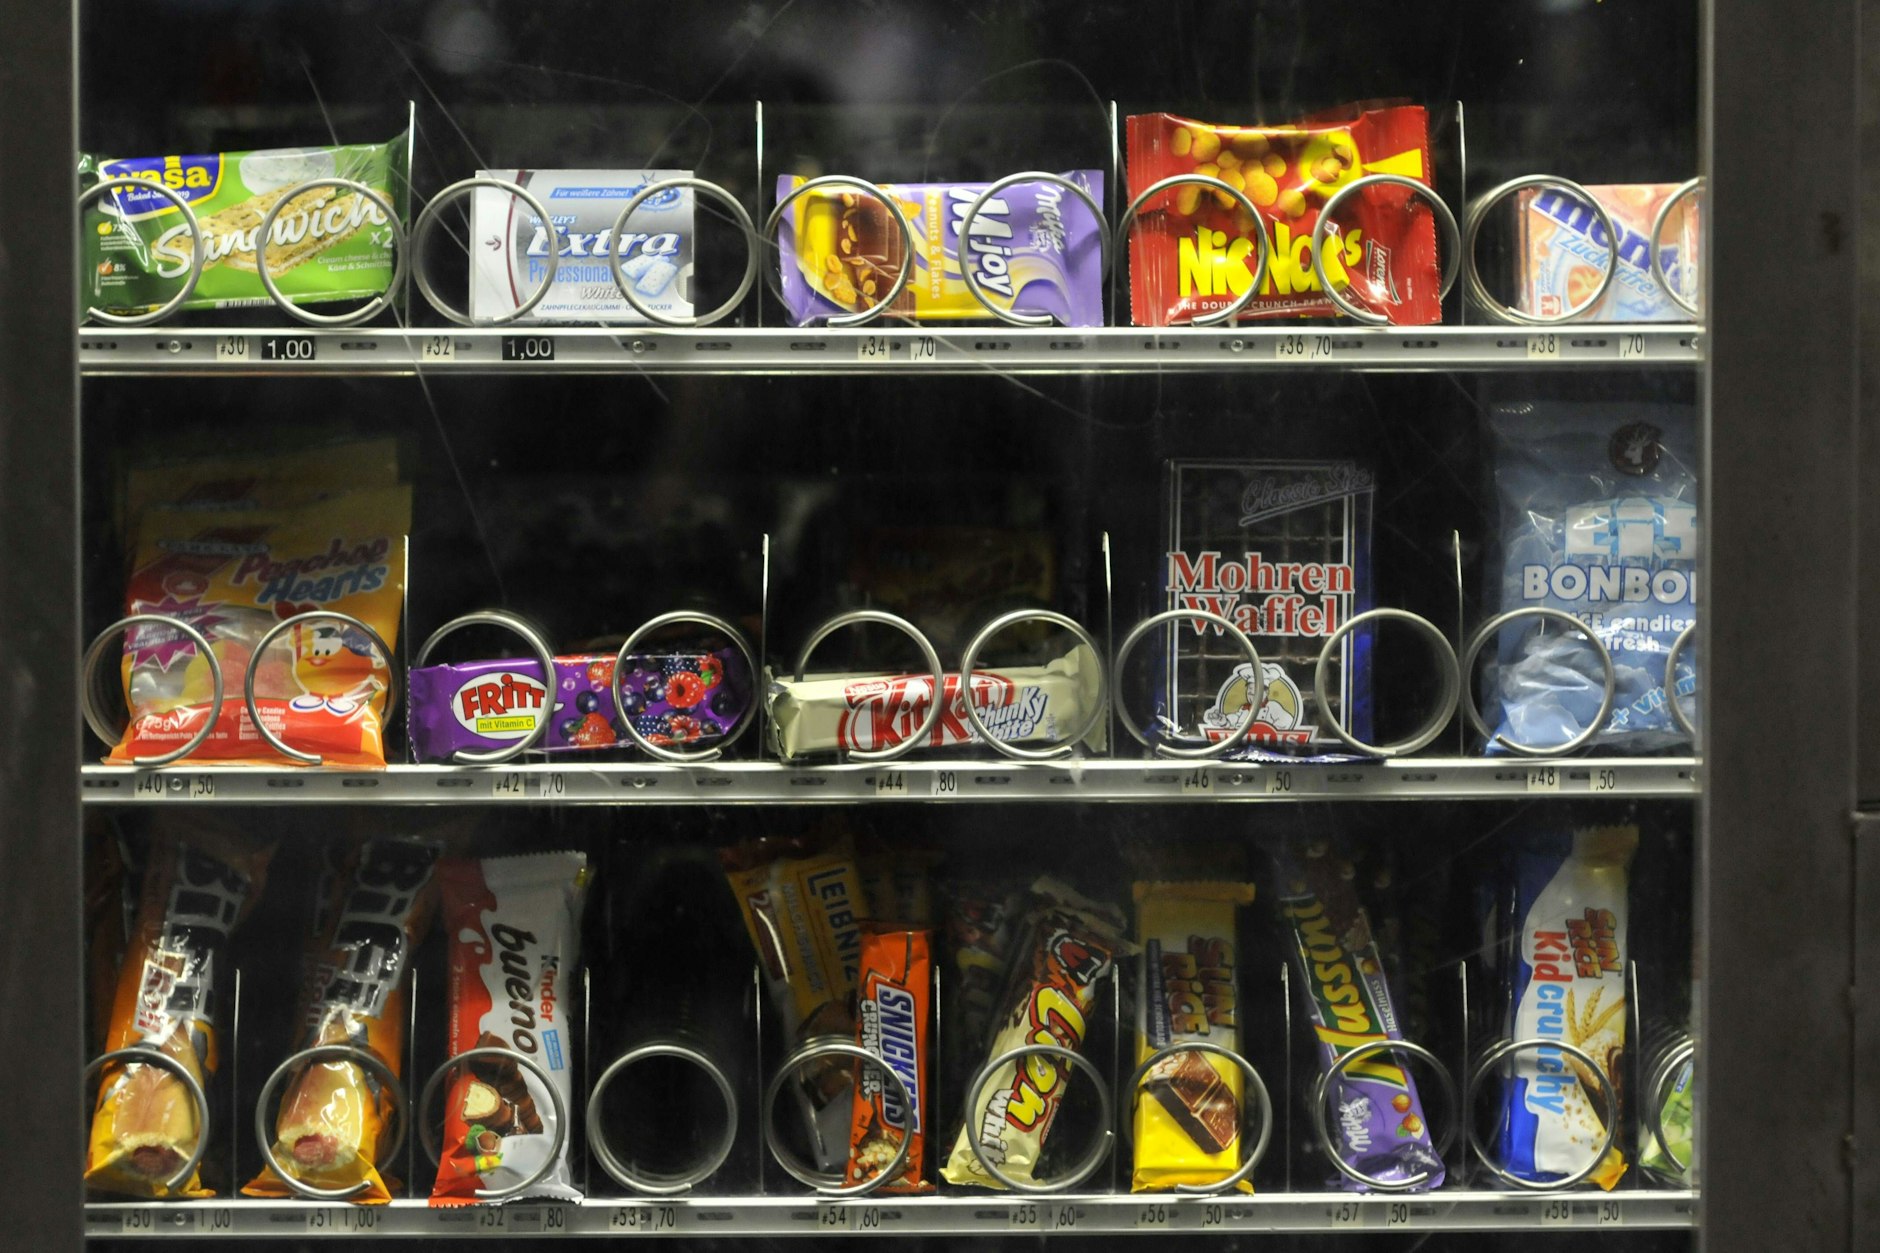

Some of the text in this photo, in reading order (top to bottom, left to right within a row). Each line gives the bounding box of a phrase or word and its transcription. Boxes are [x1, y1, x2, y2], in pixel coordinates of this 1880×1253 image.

[156, 181, 388, 278] Sandwich
[1035, 185, 1066, 255] Milka
[527, 226, 681, 256] Extra
[930, 246, 941, 255] &
[529, 260, 613, 282] Pressional
[1376, 247, 1390, 293] Loren
[1559, 235, 1661, 297] Zuckrfrei
[930, 259, 941, 299] Flakes
[220, 336, 244, 354] #30
[267, 340, 311, 360] 1,00
[426, 336, 452, 354] #32
[507, 339, 549, 360] 1,00
[862, 336, 885, 355] #34
[914, 337, 933, 360] ,70
[1279, 335, 1302, 354] #36
[1311, 336, 1329, 359] ,70
[1531, 334, 1555, 353] #38
[1623, 335, 1642, 357] ,70
[1166, 551, 1354, 593] Mohren
[257, 566, 387, 603] Hearts
[1523, 564, 1696, 604] BONBO
[1181, 594, 1340, 636] Waffel
[1605, 636, 1660, 652] fresh
[480, 719, 533, 729] mit Vitamin C
[869, 676, 991, 750] KitKat
[137, 775, 161, 793] #40
[194, 775, 213, 798] ,50
[496, 773, 519, 792] #42
[879, 773, 902, 790] #44
[936, 772, 955, 795] ,80
[1184, 770, 1207, 788] #46
[1271, 772, 1290, 793] ,50
[1532, 767, 1555, 785] #48
[1596, 770, 1615, 791] ,50
[1585, 907, 1622, 976] SUN
[451, 965, 464, 976] 2
[492, 922, 538, 1060] bueno
[1373, 979, 1397, 1032] Haselnuss
[860, 1000, 882, 1099] CRUNCER
[879, 986, 917, 1130] SNICKERS
[125, 1209, 149, 1228] #50
[200, 1209, 229, 1232] 1,00
[480, 1208, 502, 1226] #52
[544, 1208, 563, 1231] ,80
[612, 1207, 636, 1226] #53
[655, 1208, 674, 1231] ,70
[822, 1206, 845, 1224] #54
[860, 1208, 878, 1230] ,60
[1013, 1205, 1036, 1224] #55
[1055, 1206, 1075, 1229] ,60
[1141, 1204, 1164, 1223] #56
[1201, 1205, 1220, 1228] ,50
[1335, 1203, 1358, 1222] #57
[1387, 1204, 1405, 1227] ,50
[1545, 1201, 1568, 1220] #58
[1600, 1202, 1619, 1224] ,50
